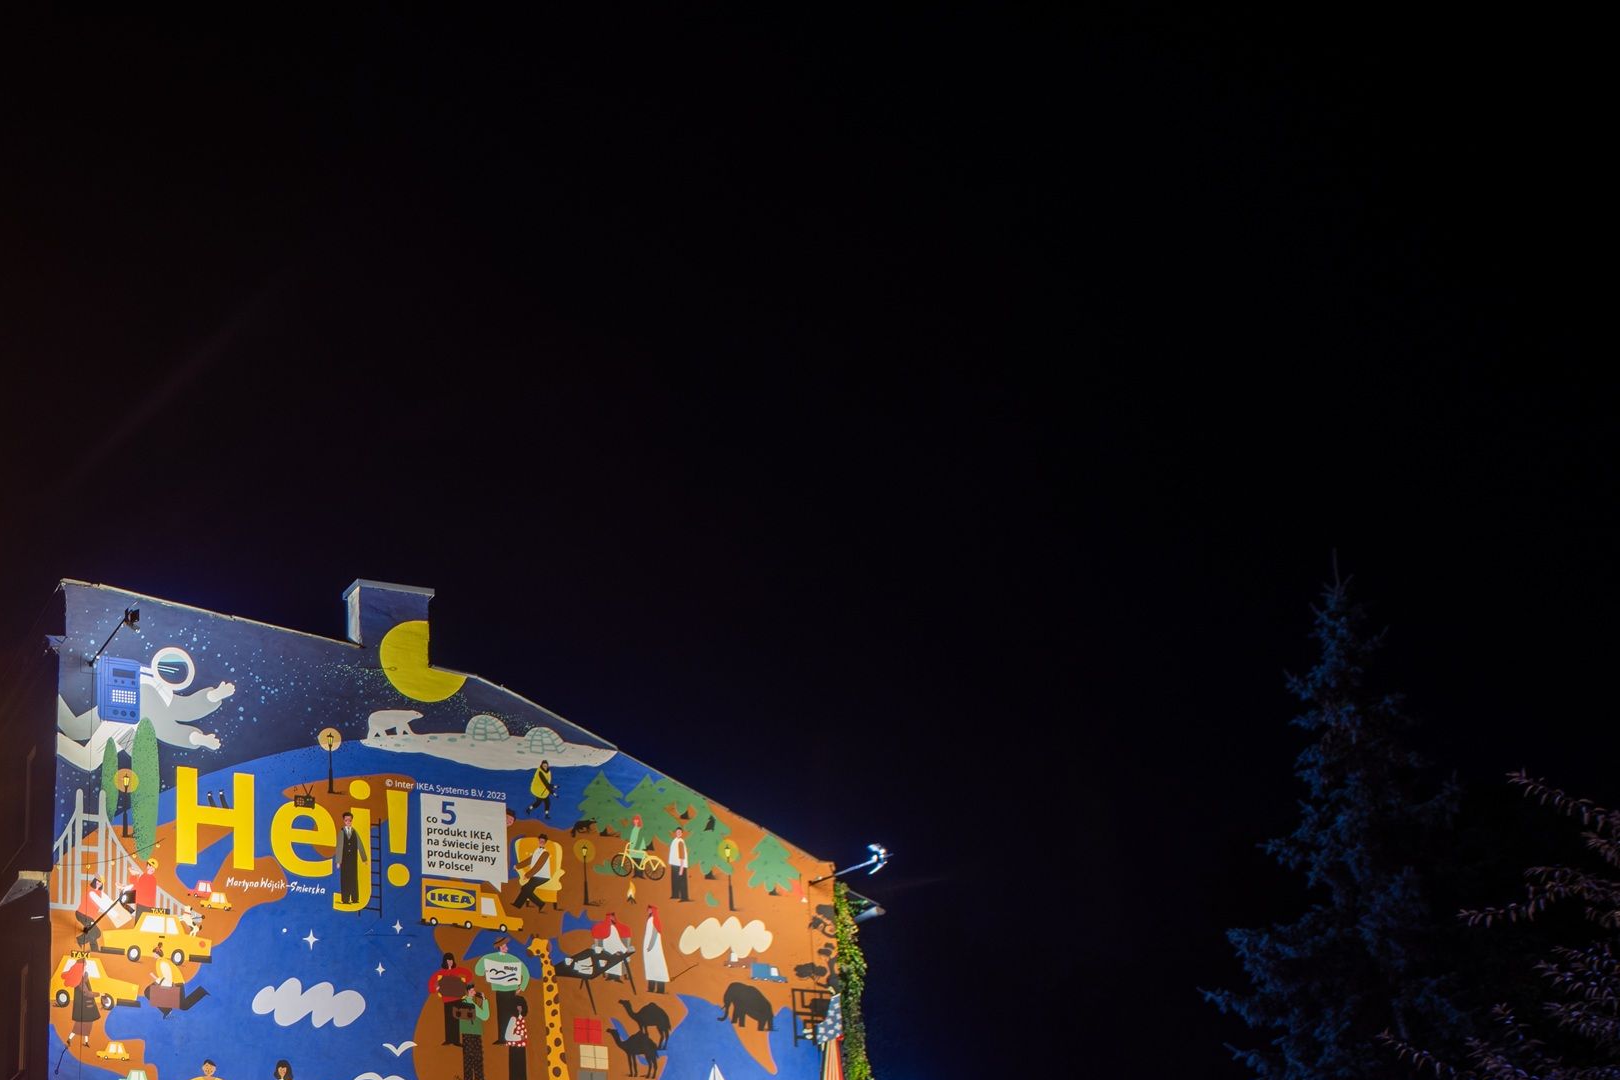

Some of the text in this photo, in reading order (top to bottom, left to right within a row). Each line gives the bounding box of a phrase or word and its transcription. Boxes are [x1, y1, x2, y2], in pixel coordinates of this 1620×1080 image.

[395, 780, 414, 789] Inter
[416, 783, 435, 792] IKEA
[436, 785, 469, 796] Systems
[471, 790, 485, 798] B.V.
[486, 791, 506, 801] 2023
[426, 801, 457, 825] co 5
[176, 766, 410, 912] Hej!
[427, 827, 492, 840] produkt IKEA
[442, 838, 479, 851] świecie
[481, 843, 500, 854] jest
[427, 849, 497, 866] produkowany
[427, 860, 474, 872] w Polsce!
[226, 877, 259, 892] Martyna
[430, 892, 472, 904] IKEA
[72, 951, 91, 960] TAXI
